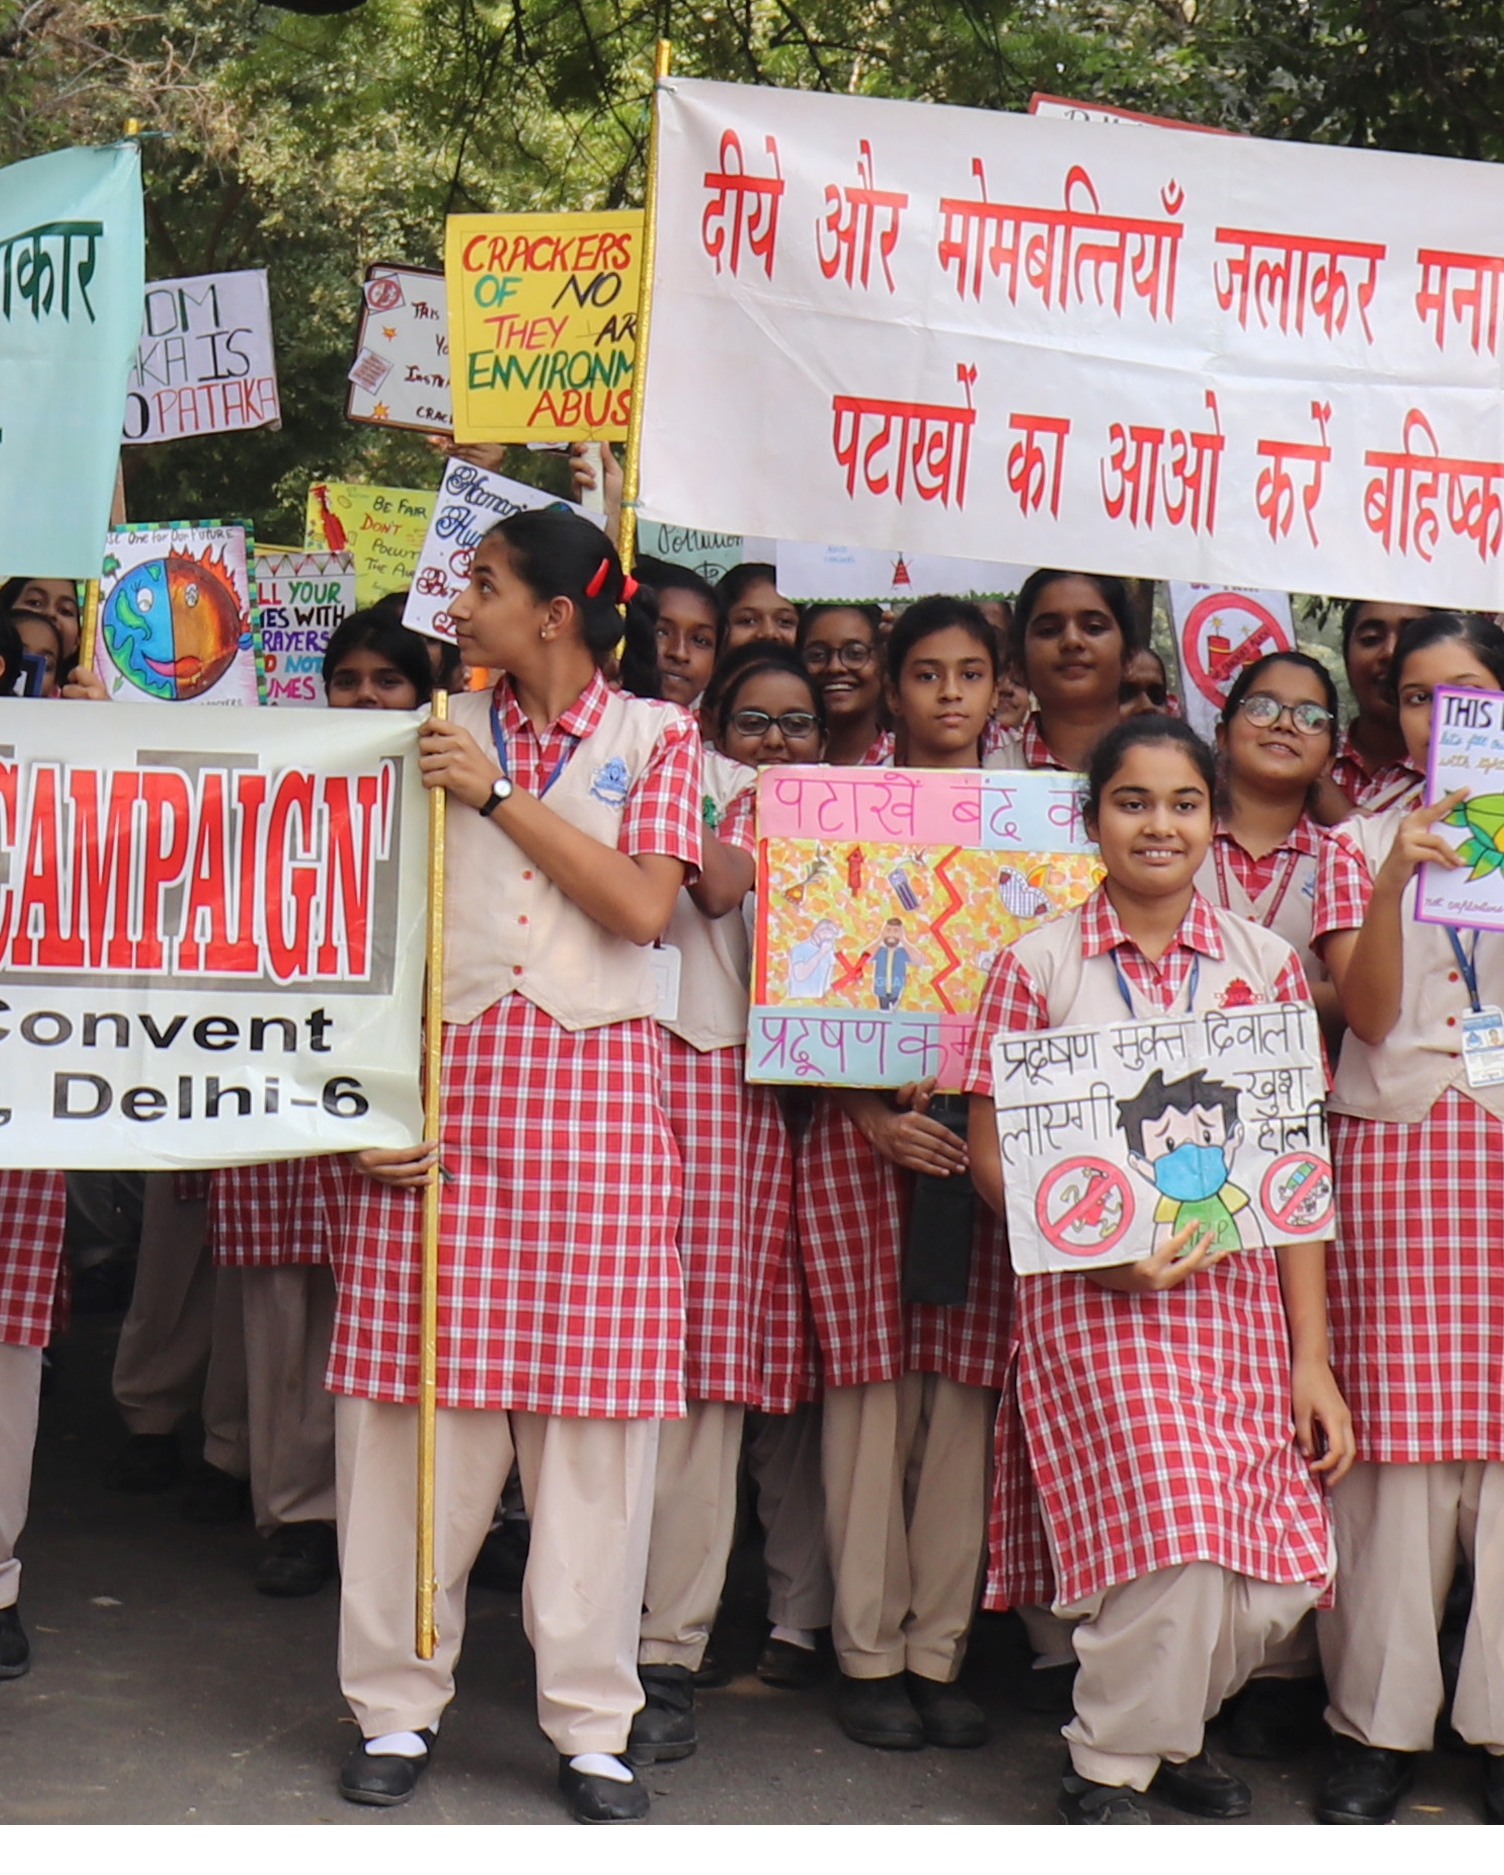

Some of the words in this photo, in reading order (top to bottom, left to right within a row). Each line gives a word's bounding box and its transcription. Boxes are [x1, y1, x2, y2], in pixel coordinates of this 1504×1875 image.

[463, 232, 633, 273] CRACKERS
[701, 127, 786, 283] दीये
[815, 138, 910, 295] और
[936, 156, 1186, 325] मोमबत्तियाँ
[1212, 225, 1389, 346] जलाकर
[473, 274, 524, 308] OF
[551, 271, 623, 310] NO
[195, 327, 254, 382] IS
[484, 313, 570, 351] THEY
[151, 376, 280, 434] PATAKA
[830, 361, 979, 513] पटाखों
[1006, 412, 1072, 523] का
[1099, 388, 1227, 539] आओ
[1254, 398, 1334, 551] करें
[287, 580, 343, 606] YOUR
[293, 604, 346, 628] WITH
[1442, 695, 1493, 729] THIS
[949, 777, 1023, 843] बंद
[756, 1015, 894, 1078] प्रदूषण
[997, 1031, 1101, 1086] प्रदूषण
[1110, 1019, 1197, 1071] मुक्त
[1202, 1003, 1308, 1057] दिवाली
[51, 1069, 372, 1124] Delhi-6
